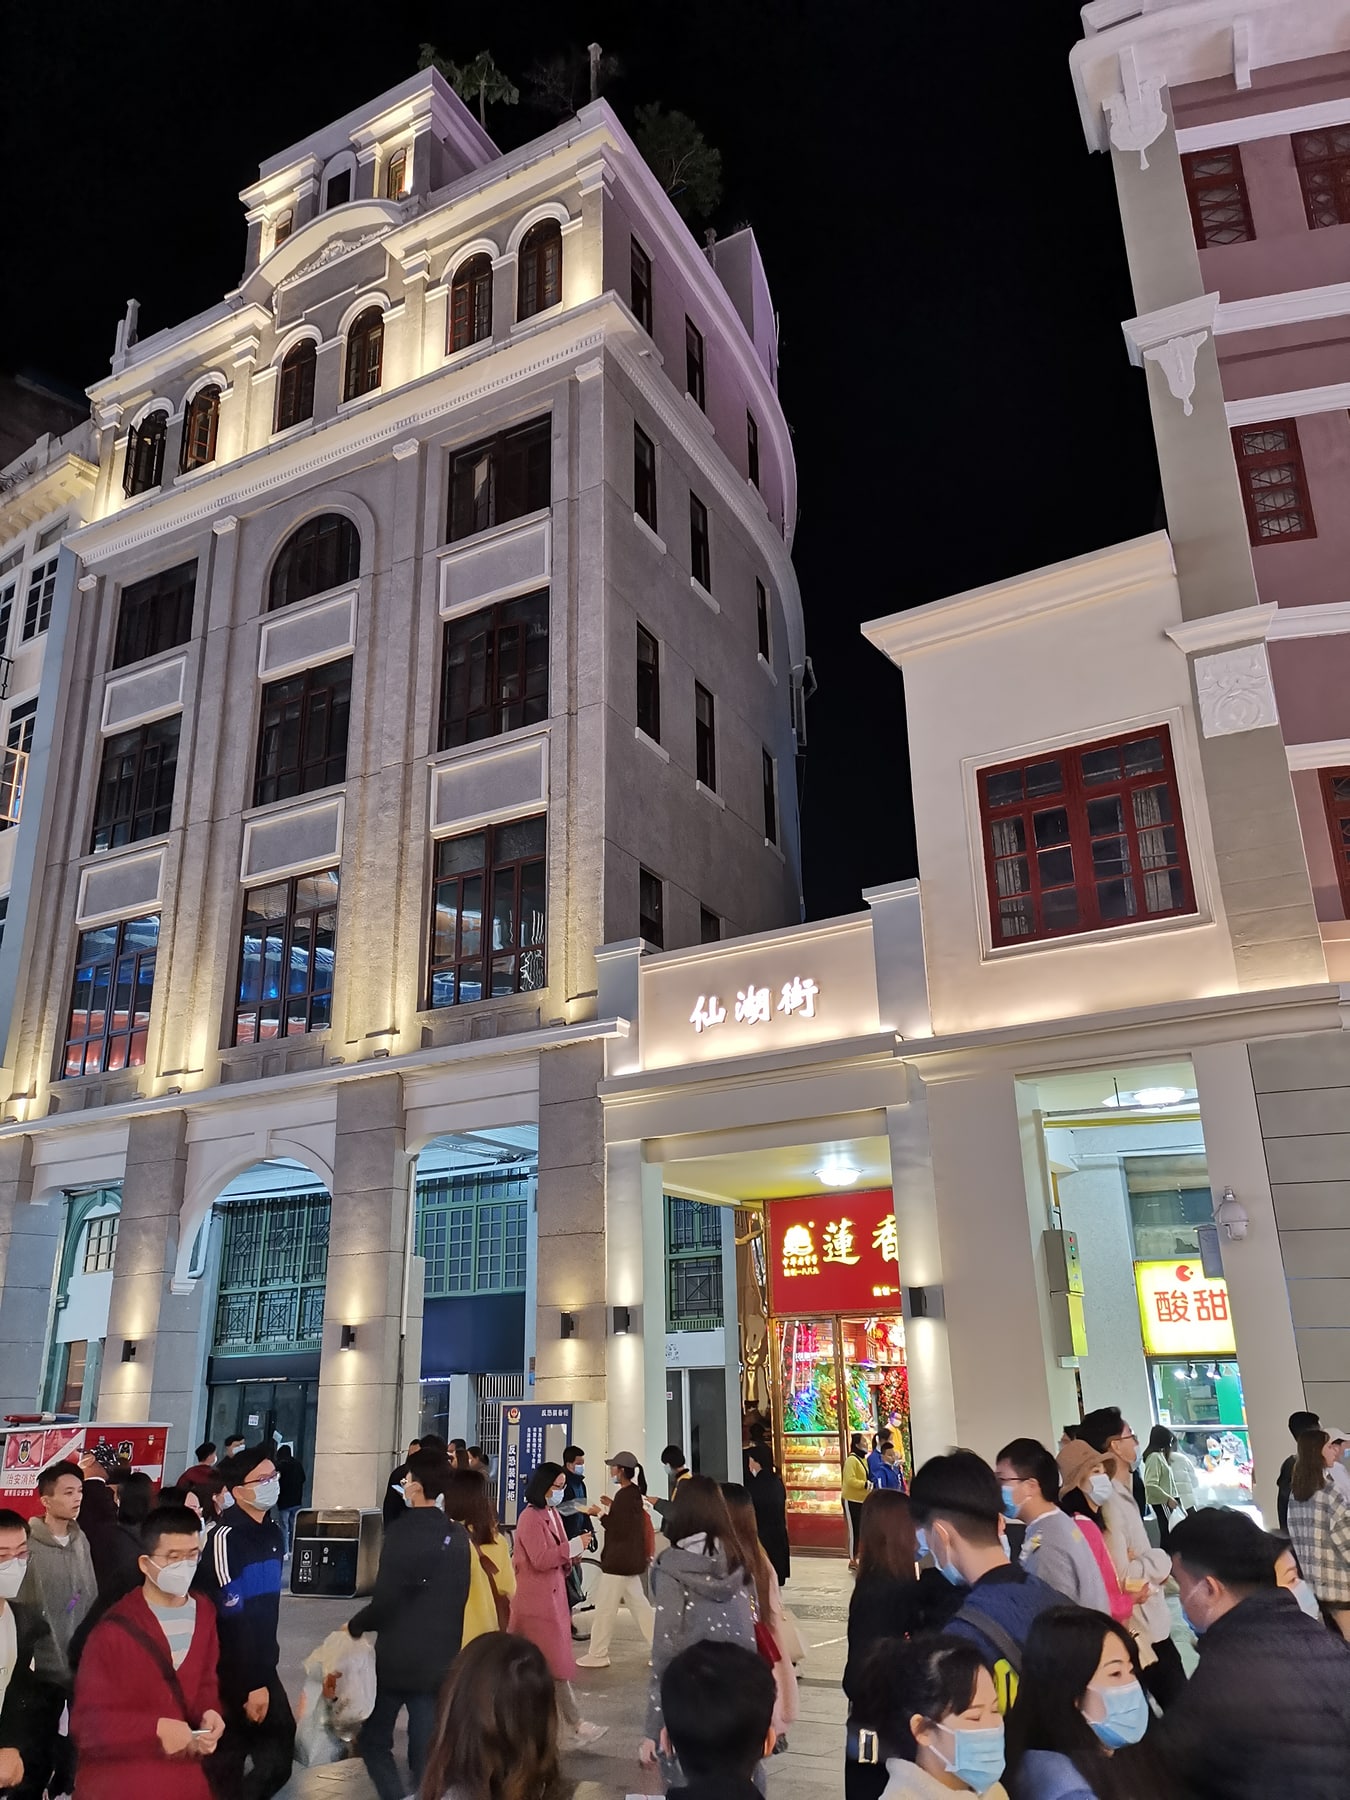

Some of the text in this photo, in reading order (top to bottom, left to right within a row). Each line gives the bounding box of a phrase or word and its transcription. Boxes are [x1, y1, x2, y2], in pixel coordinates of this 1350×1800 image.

[690, 976, 820, 1033] 仙湖街
[1154, 1288, 1228, 1323] 酸甜
[507, 1444, 517, 1502] 反恐装备柜
